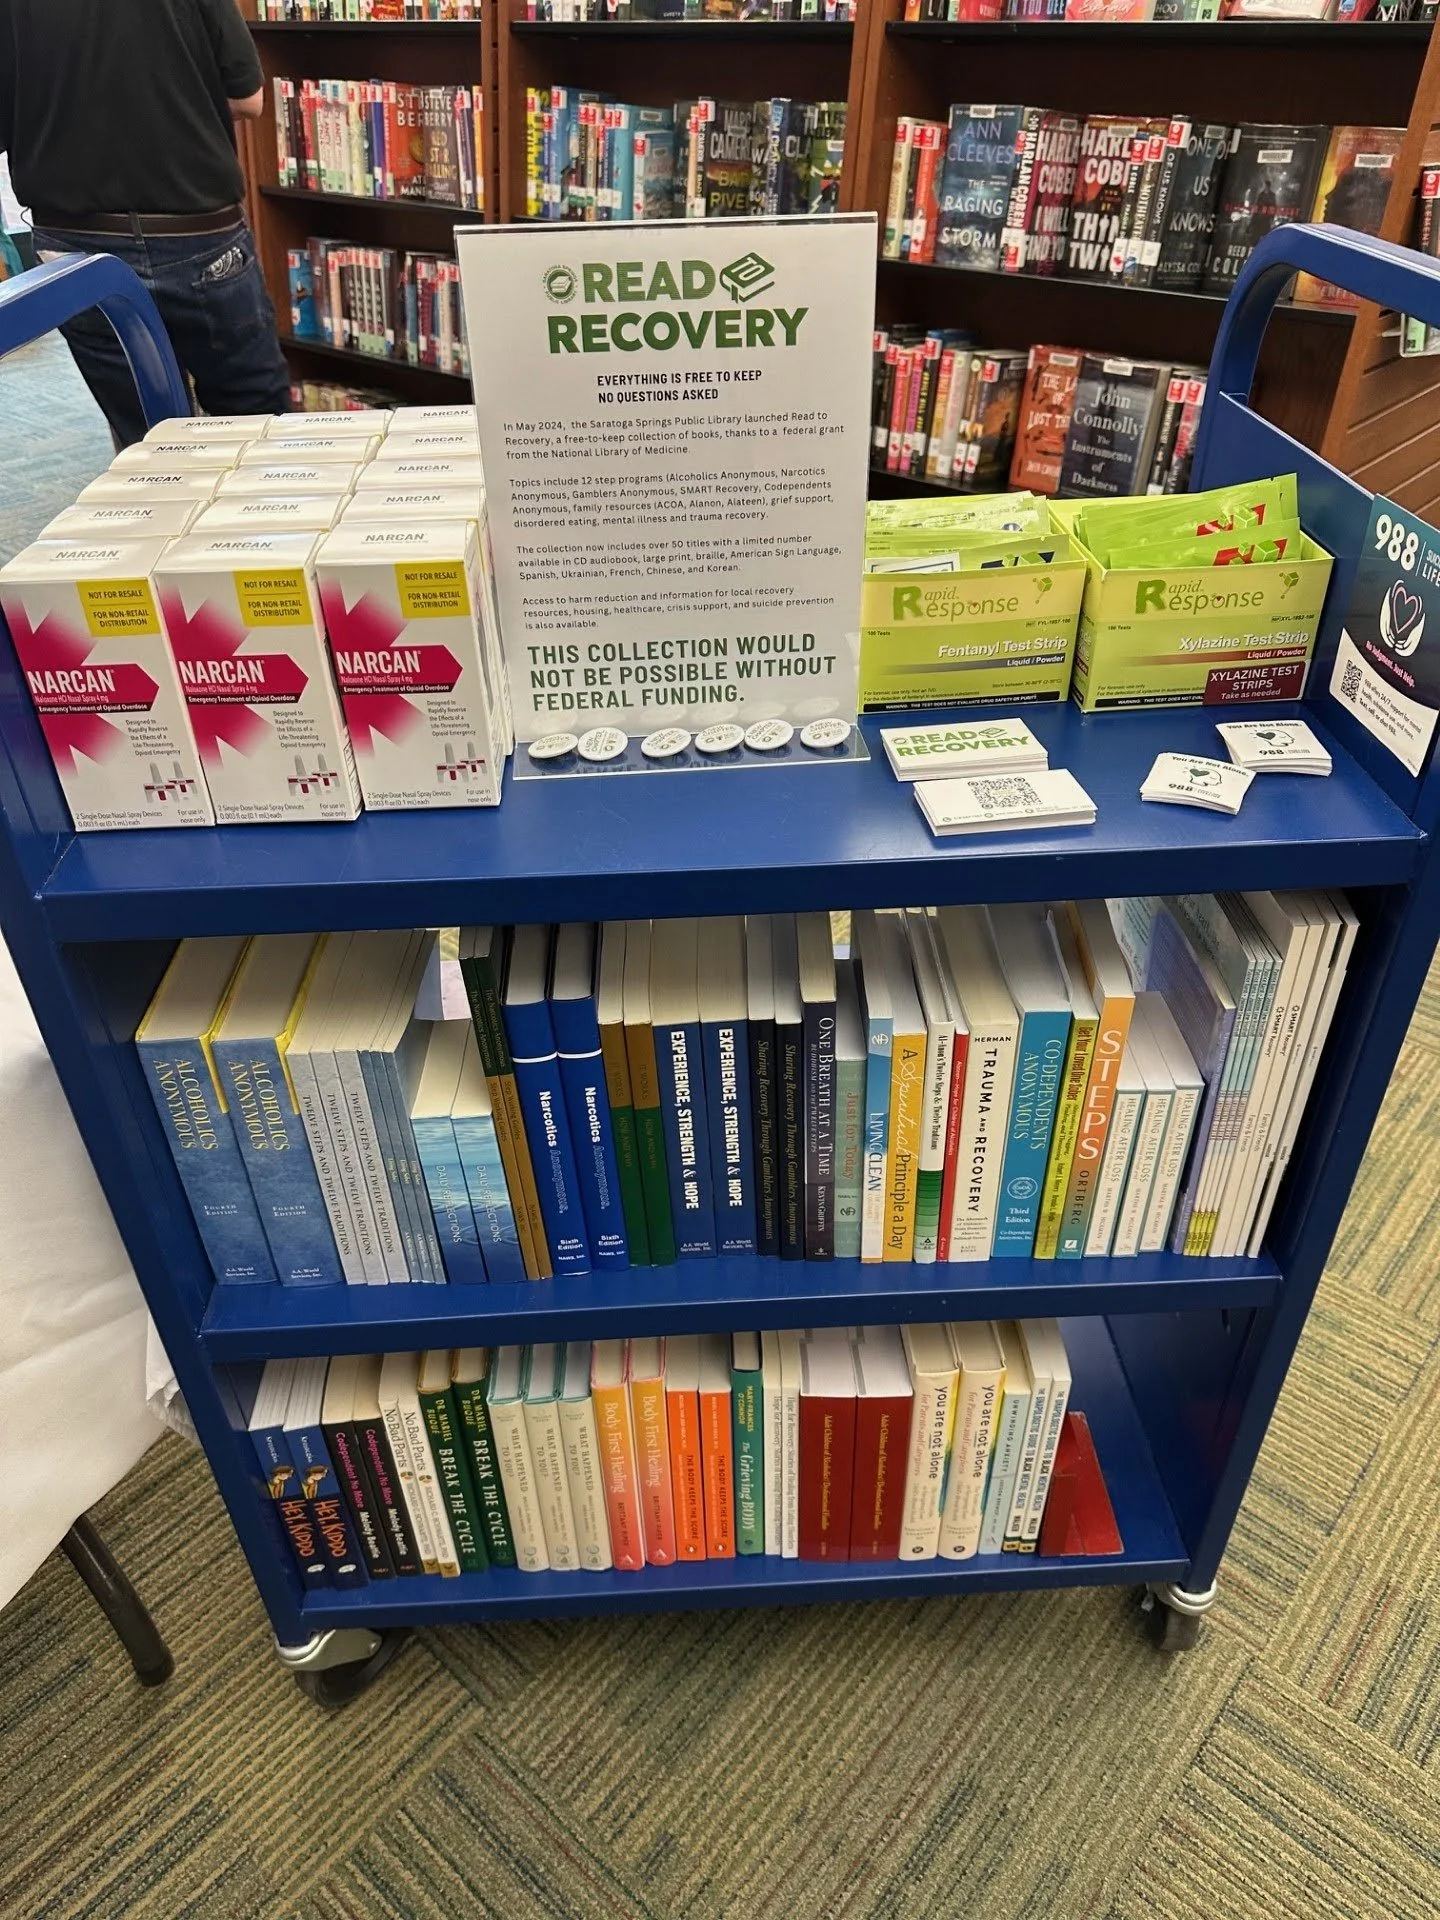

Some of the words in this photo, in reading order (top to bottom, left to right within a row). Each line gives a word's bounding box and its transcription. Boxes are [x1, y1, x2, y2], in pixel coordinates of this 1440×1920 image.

[964, 120, 1003, 140] ANN
[947, 143, 1014, 164] CLEEVES
[968, 179, 985, 189] THE
[944, 195, 1004, 216] RAGING
[941, 227, 996, 249] STORM
[582, 260, 716, 302] READ
[731, 257, 766, 281] TO
[547, 307, 809, 354] RECOVERY
[597, 374, 668, 386] EVERYTHING
[671, 374, 682, 384] IS
[685, 372, 713, 384] FREE
[716, 372, 730, 382] TO
[734, 370, 762, 381] KEEP
[598, 392, 614, 404] NO
[617, 390, 679, 403] QUESTIONS
[682, 389, 718, 400] ASKED
[1090, 385, 1132, 409] John
[504, 423, 513, 431] In
[516, 423, 535, 432] May
[538, 422, 566, 431] 2024,
[571, 421, 587, 429] the
[590, 419, 633, 429] Saratoga
[636, 418, 672, 428] Springs
[675, 416, 705, 425] Public
[708, 416, 741, 425] Library
[745, 414, 788, 423] launched
[792, 412, 815, 420] Read
[818, 412, 828, 420] to
[1074, 407, 1143, 441] Connolly
[505, 437, 554, 446] Recovery,
[564, 435, 625, 444] free-to-keep
[628, 432, 675, 441] collection
[679, 431, 688, 439] of
[691, 430, 722, 439] books,
[725, 429, 756, 437] thanks
[783, 426, 817, 435] federal
[819, 426, 844, 436] grant
[506, 451, 530, 459] from
[551, 449, 592, 458] National
[595, 448, 629, 457] Library
[632, 447, 641, 455] of
[1072, 440, 1133, 463] Instruments
[1072, 471, 1118, 492] Darkness
[366, 533, 426, 541] NARCAN
[1374, 513, 1419, 571] 988
[88, 591, 102, 599] NOT
[118, 589, 143, 597] RESALE
[274, 579, 297, 587] RESALE
[93, 611, 105, 619] FOR
[107, 610, 149, 618] NON-RETAIL
[254, 608, 300, 616] DISTRIBUTION
[262, 600, 302, 608] NON-RETAIL
[100, 619, 147, 627] DISTRIBUTION
[527, 645, 580, 665] THIS
[588, 638, 728, 662] COLLECTION
[736, 633, 815, 655] WOULD
[939, 642, 1000, 658] Fentanyl
[1004, 639, 1031, 651] Test
[1034, 636, 1068, 650] Strip
[1179, 636, 1240, 651] Xylazine
[1244, 634, 1272, 646] Test
[1275, 631, 1309, 645] Strip
[1007, 657, 1031, 667] Liquid
[1036, 655, 1064, 664] Powder
[1248, 650, 1271, 660] Liquid
[1277, 648, 1306, 657] Powder
[530, 669, 575, 688] NOT
[584, 667, 612, 686] BE
[619, 662, 728, 684] POSSIBLE
[736, 656, 836, 678] WITHOUT
[1210, 667, 1269, 682] XYLAZINE
[1271, 665, 1299, 676] TEST
[1232, 680, 1273, 690] STRIPS
[1251, 688, 1281, 698] needed
[533, 690, 634, 711] FEDERAL
[642, 684, 744, 706] FUNDING.
[896, 737, 1029, 756] RECOVERY
[909, 731, 977, 744] READ
[818, 1017, 834, 1049] ONE
[903, 1048, 918, 1061] A
[670, 1030, 691, 1108] EXPERIENCE,
[819, 1053, 833, 1103] BREATH
[978, 1048, 997, 1115] TRAUMA
[154, 1061, 198, 1149] ANONYMOUS
[174, 1058, 219, 1151] ALCOHOLICS
[1014, 1052, 1040, 1140] ANONYMOUS
[1031, 1039, 1062, 1150] CO-DEPENDENTS
[1077, 1029, 1123, 1160] STEPS
[539, 1090, 557, 1147] Narcotics
[585, 1086, 601, 1143] Narcotics
[819, 1105, 830, 1127] AT
[891, 1059, 922, 1163] Spiritual
[1121, 1097, 1136, 1132] HEALING
[869, 1113, 883, 1152] LIVING
[979, 1118, 987, 1132] AND
[677, 1107, 697, 1167] STRENGTH
[819, 1134, 830, 1144] A
[1115, 1134, 1129, 1160] AFTER
[818, 1144, 833, 1176] TIME
[682, 1168, 697, 1179] &
[867, 1153, 883, 1191] CLEAN
[889, 1153, 911, 1212] Principle
[968, 1137, 988, 1212] RECOVERY
[1111, 1162, 1122, 1182] LOSS
[685, 1181, 699, 1210] HOPE
[1071, 1169, 1090, 1226] ORTBERG
[888, 1222, 907, 1249] Day
[934, 1386, 948, 1408] you
[605, 1402, 619, 1432] Body
[935, 1409, 945, 1427] are
[608, 1432, 623, 1454] First
[930, 1429, 943, 1449] not
[439, 1448, 459, 1487] BREAK
[610, 1456, 628, 1494] Healing
[928, 1451, 940, 1479] alone
[450, 1493, 467, 1514] THE
[455, 1520, 476, 1554] CYCLE
